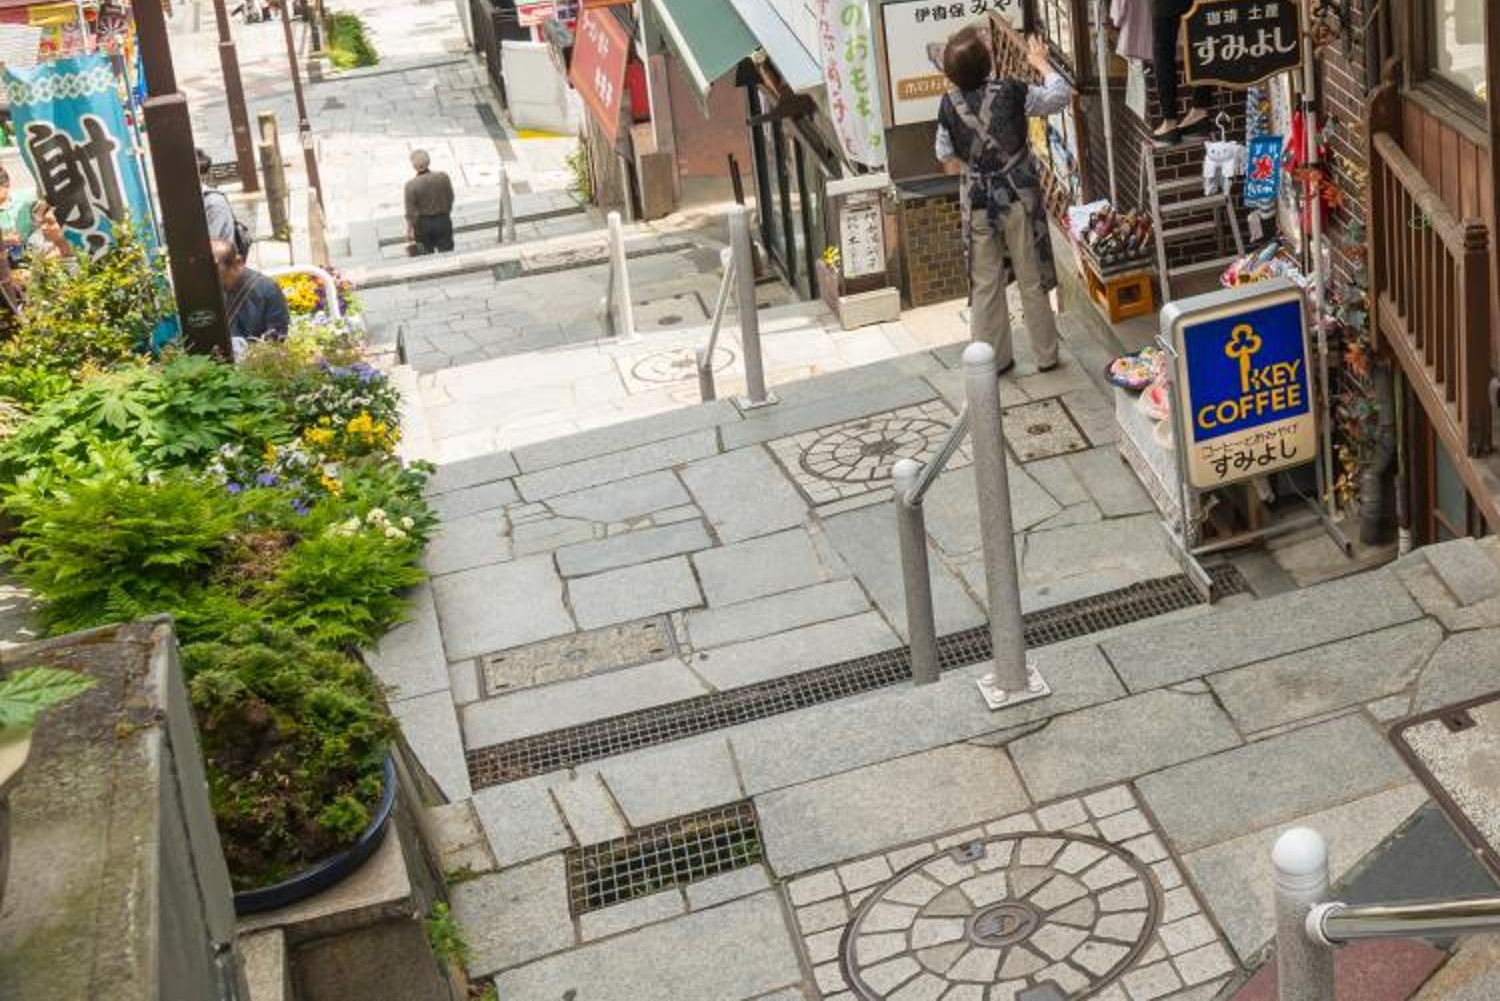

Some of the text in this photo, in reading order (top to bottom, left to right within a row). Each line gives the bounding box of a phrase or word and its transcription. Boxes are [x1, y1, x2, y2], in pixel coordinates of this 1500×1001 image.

[1192, 26, 1297, 66] すみよし
[1250, 358, 1301, 390] KEY
[1197, 384, 1301, 429] COFFEE
[1211, 439, 1297, 478] すみよし
